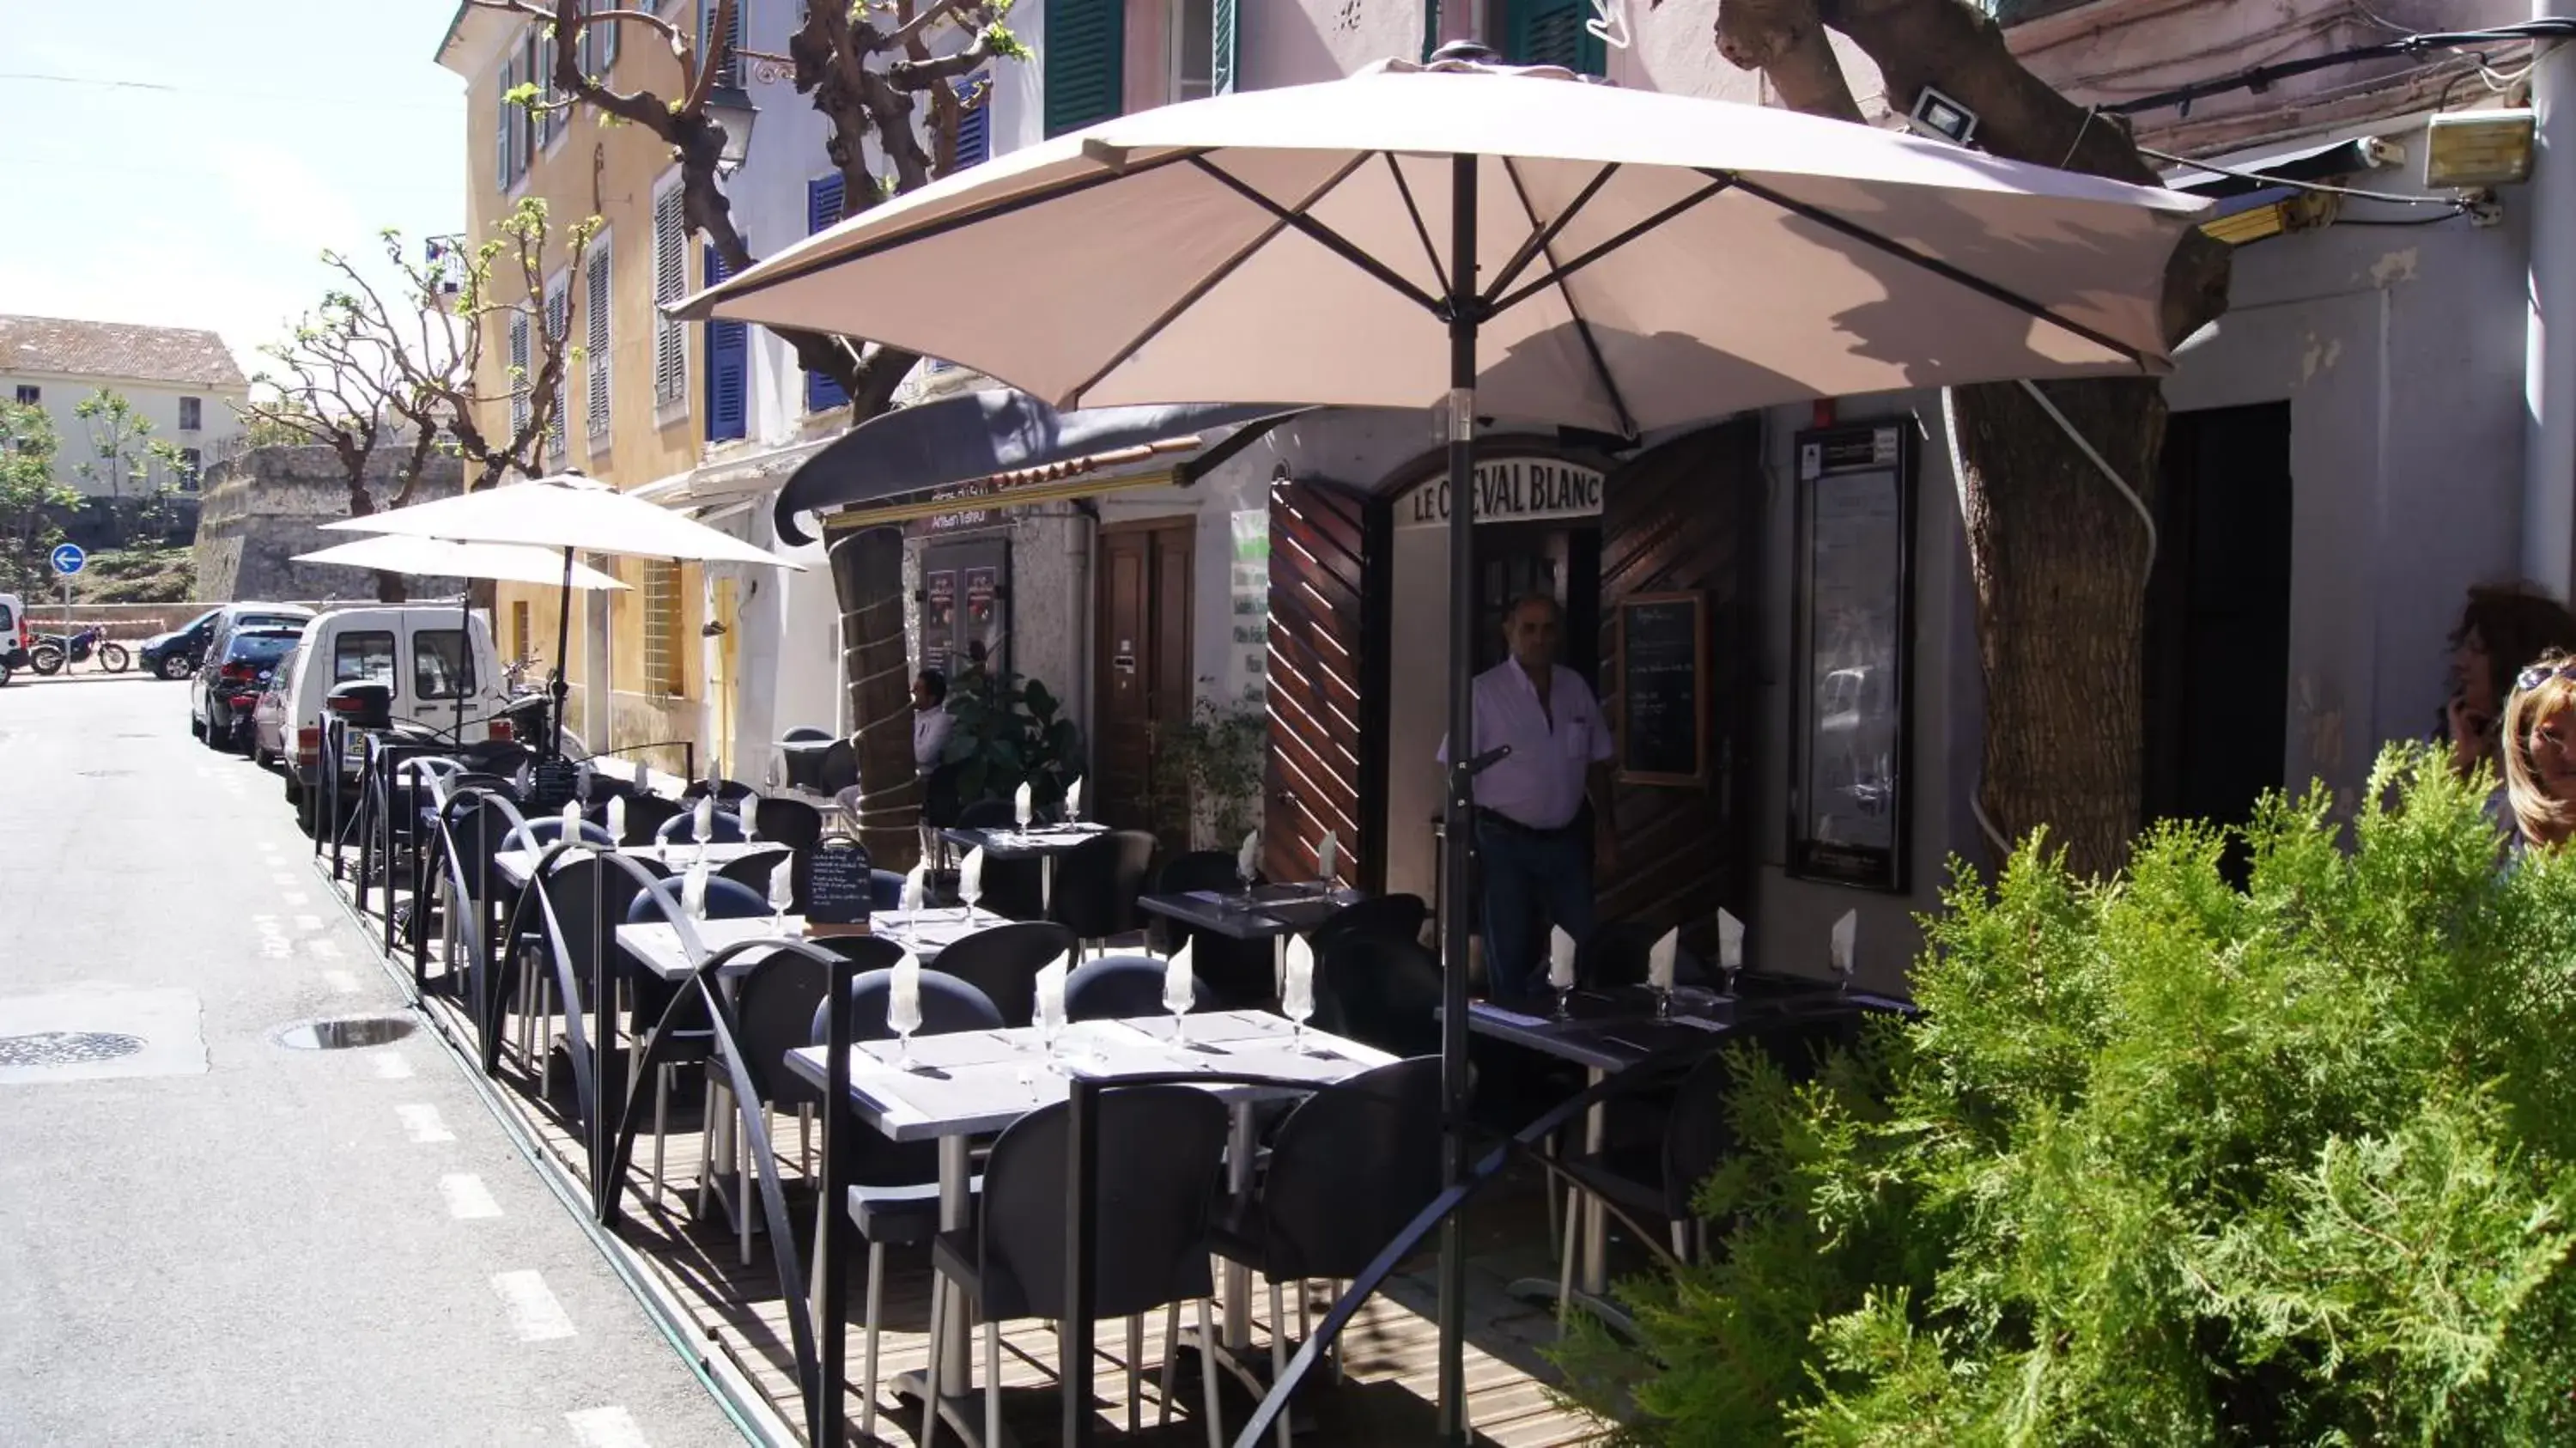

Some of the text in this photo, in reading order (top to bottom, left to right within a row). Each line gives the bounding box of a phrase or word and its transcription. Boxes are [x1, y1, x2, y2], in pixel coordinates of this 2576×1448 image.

[1414, 464, 1601, 520] LE CEVAL BLANC
